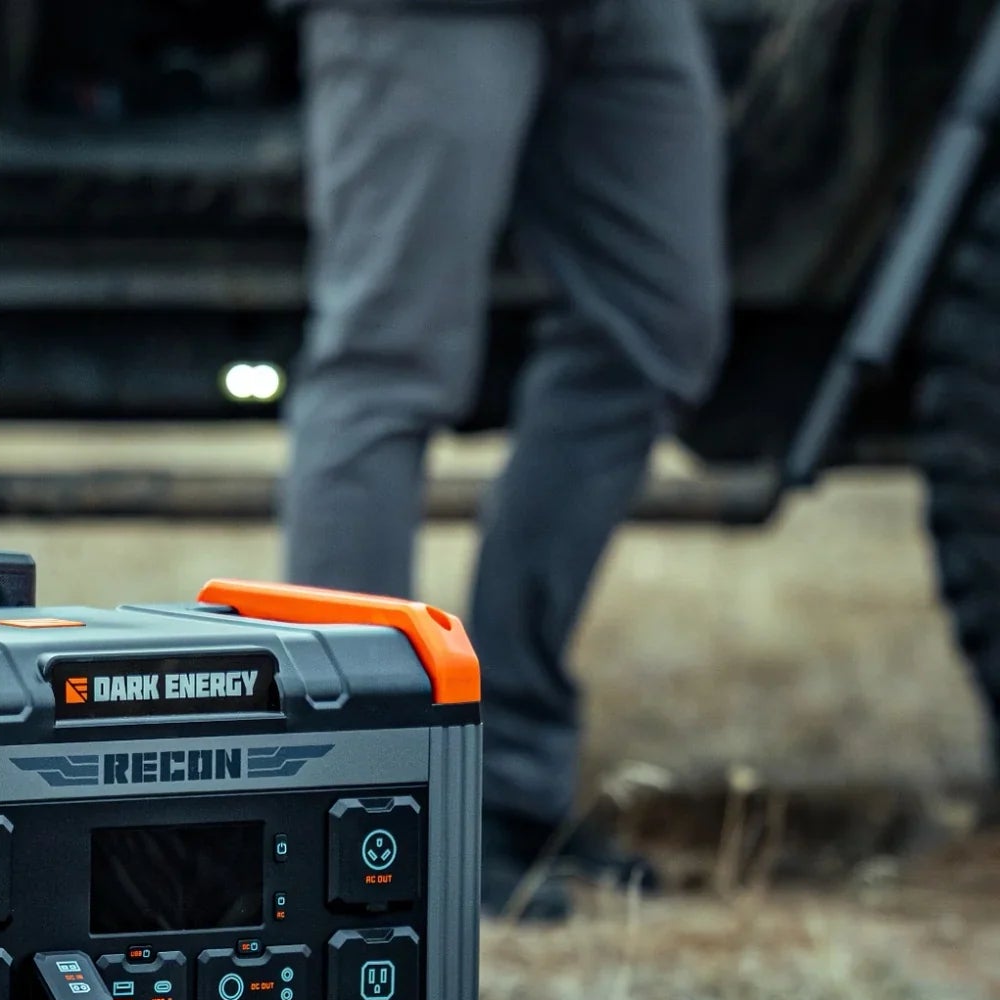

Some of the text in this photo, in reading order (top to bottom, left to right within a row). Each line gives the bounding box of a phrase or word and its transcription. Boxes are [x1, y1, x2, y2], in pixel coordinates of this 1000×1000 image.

[93, 670, 258, 702] DARK ENERGY
[103, 748, 241, 785] RECON
[365, 874, 393, 884] AC OUT
[250, 981, 275, 991] DC OUT
